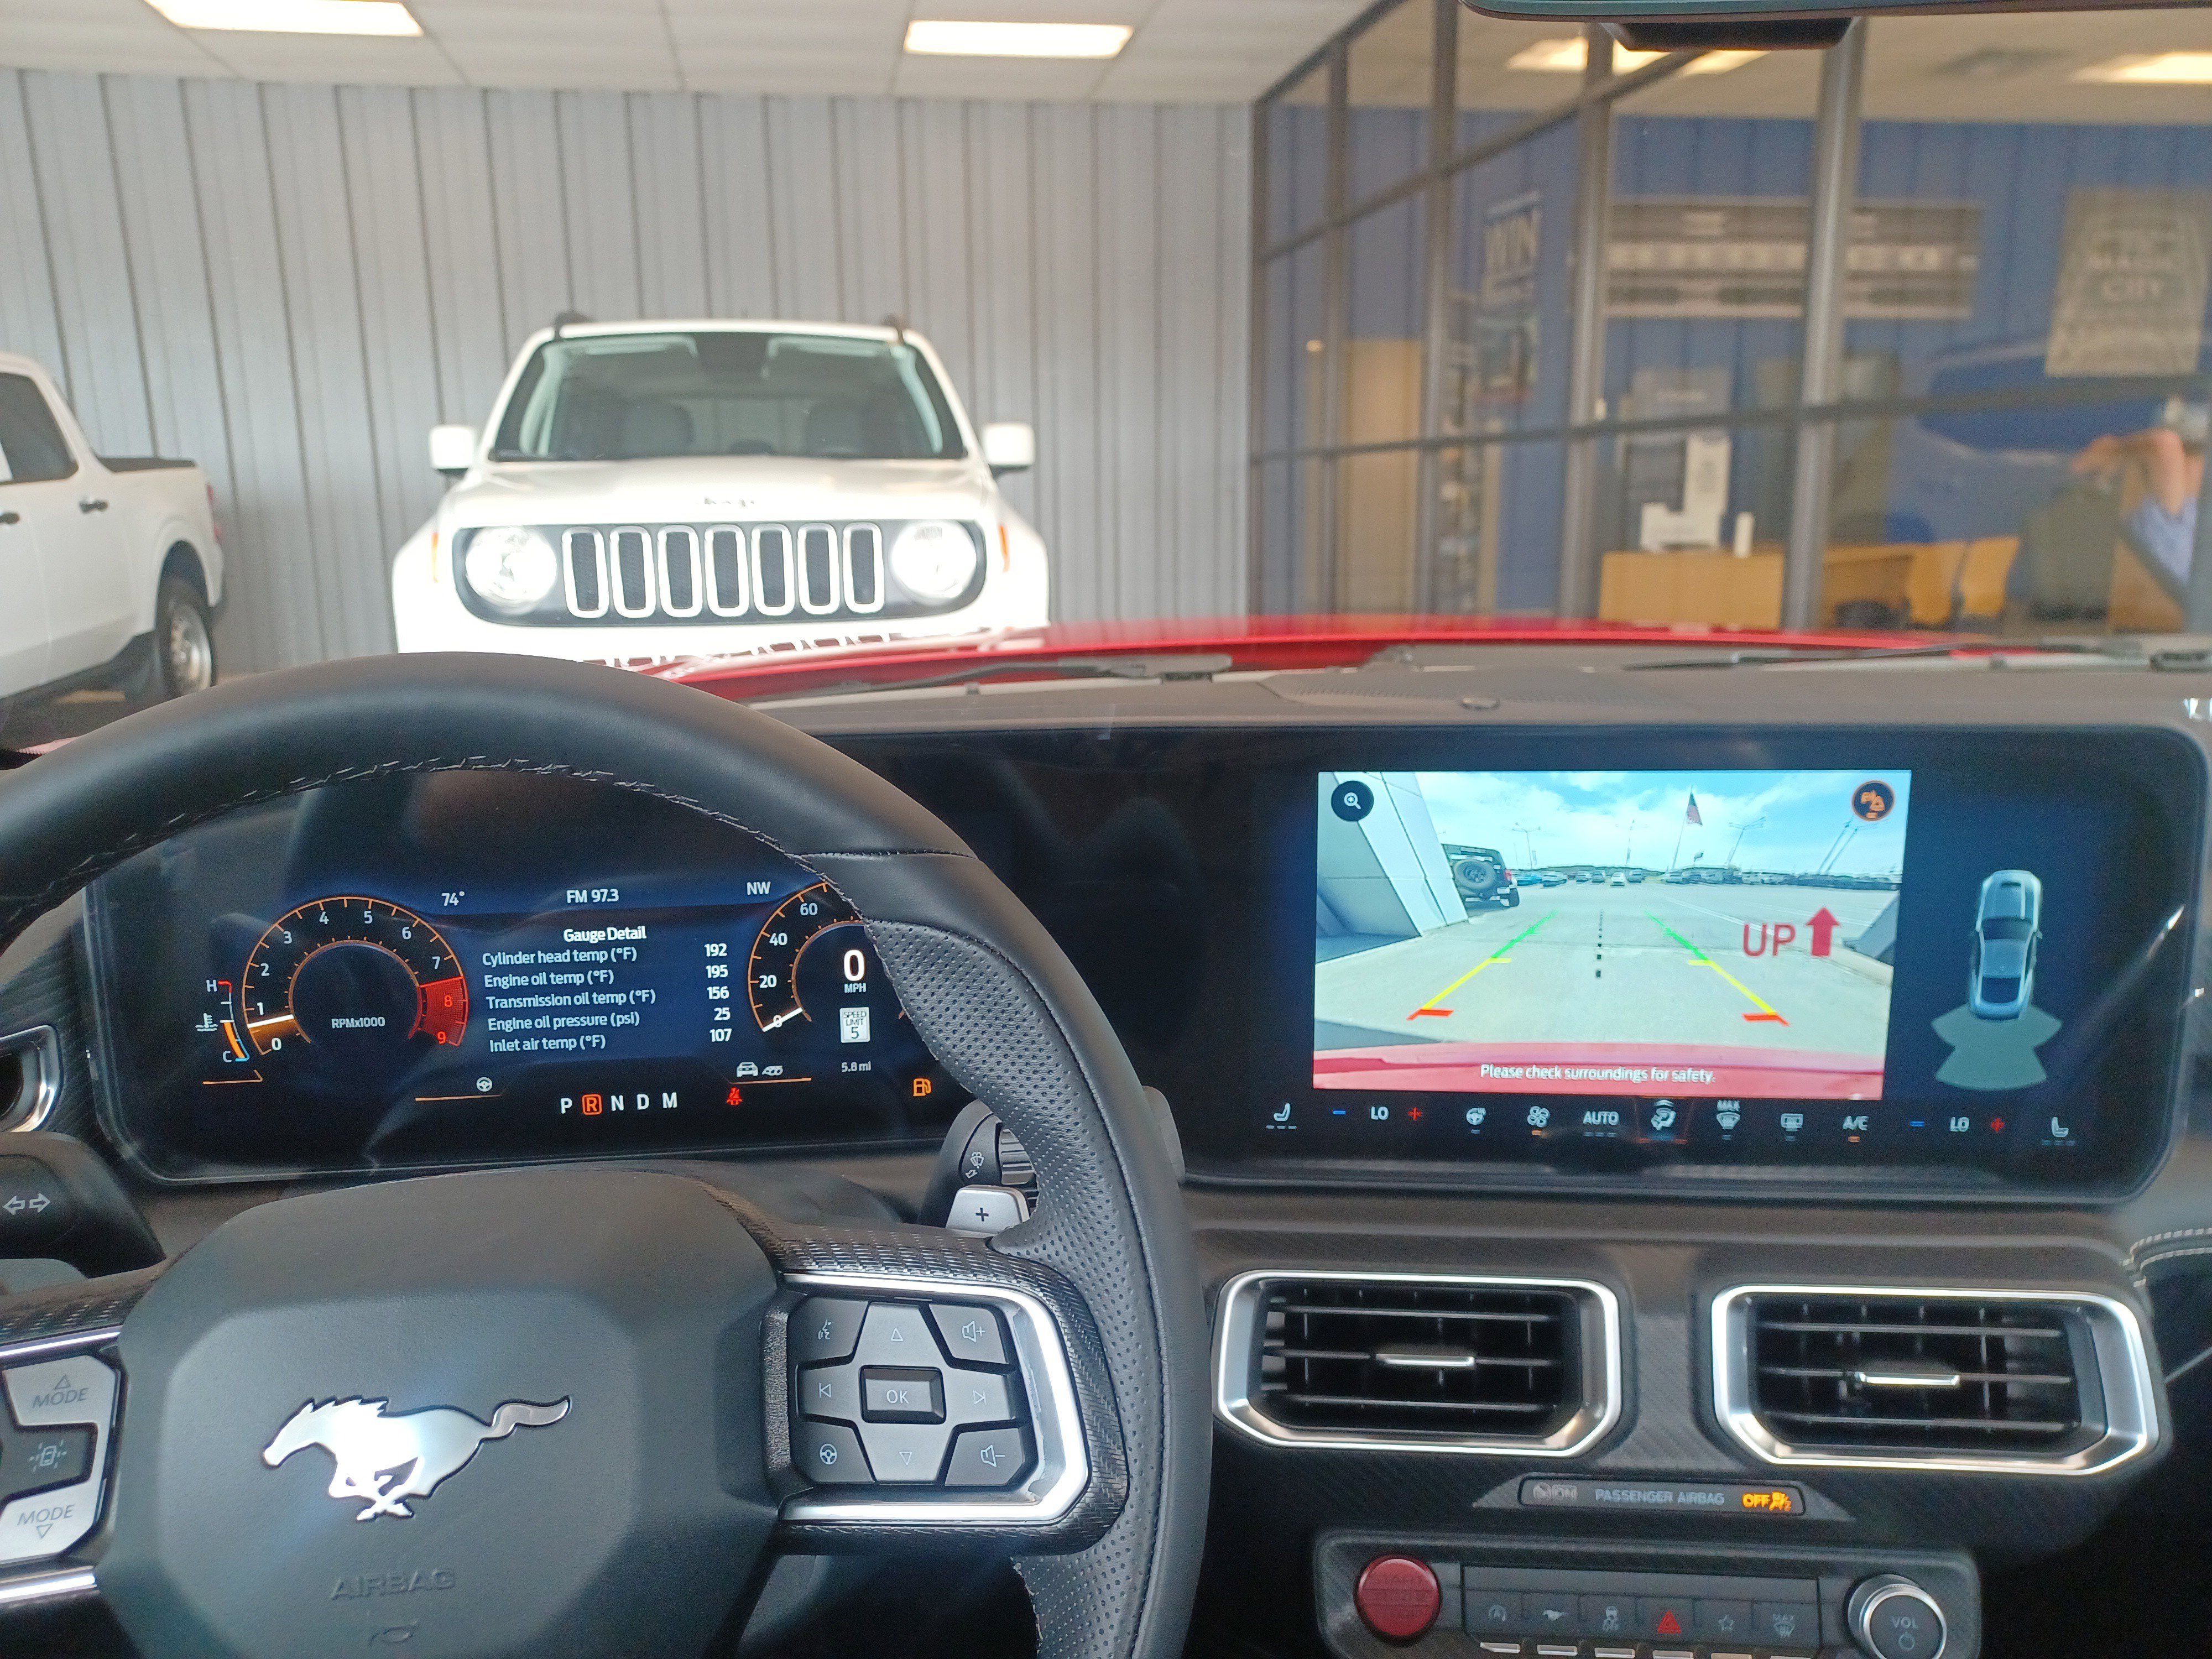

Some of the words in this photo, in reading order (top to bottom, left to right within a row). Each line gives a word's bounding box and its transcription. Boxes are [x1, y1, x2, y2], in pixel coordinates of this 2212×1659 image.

[747, 881, 771, 895] NW
[566, 889, 588, 904] FM
[591, 888, 619, 902] 97.3
[800, 902, 818, 916] 60
[319, 911, 330, 925] 4
[364, 910, 373, 924] 5
[283, 931, 293, 944] 3
[401, 926, 412, 940] 6
[563, 928, 606, 944] Gauge
[606, 925, 647, 941] Detail
[769, 932, 788, 946] 40
[1743, 923, 1796, 957] UP
[432, 956, 441, 969] 7
[482, 951, 536, 968] Cylinder
[537, 949, 571, 963] head
[572, 949, 608, 963] temp
[704, 943, 727, 957] 192
[260, 963, 270, 977] 2
[843, 949, 865, 982] 0
[484, 974, 529, 989] Engine
[530, 972, 548, 985] oil
[549, 972, 585, 986] temp
[705, 964, 728, 978] 195
[759, 974, 777, 988] 20
[206, 979, 217, 992] H
[844, 982, 867, 993] MPH
[444, 994, 453, 1008] 8
[485, 993, 572, 1009] Transmission
[573, 992, 590, 1005] oil
[591, 992, 627, 1006] temp
[706, 985, 729, 1000] 156
[257, 1001, 264, 1015] 1
[843, 1010, 867, 1019] SPEED
[331, 1016, 385, 1029] RPMx1000
[488, 1017, 533, 1032] Engine
[534, 1015, 551, 1029] oil
[552, 1015, 608, 1030] pressure
[610, 1011, 640, 1027] (psi)
[713, 1007, 731, 1021] 25
[436, 1030, 447, 1045] 9
[851, 1026, 859, 1039] 5
[271, 1037, 282, 1051] 0
[489, 1039, 521, 1052] Inlet
[522, 1037, 540, 1051] air
[541, 1037, 577, 1051] temp
[709, 1028, 732, 1042] 107
[222, 1050, 232, 1063] C
[841, 1062, 858, 1072] 5.8
[1480, 1064, 1523, 1079] Please
[1525, 1065, 1562, 1080] check
[1564, 1066, 1647, 1083] surroundings
[1651, 1067, 1669, 1081] for
[1672, 1067, 1716, 1084] safety.
[560, 1098, 572, 1114] P
[585, 1097, 599, 1113] R
[611, 1095, 624, 1112] N
[637, 1094, 650, 1110] D
[662, 1092, 677, 1109] M
[1371, 1106, 1389, 1120] LO
[1583, 1111, 1620, 1126] AUTO
[1950, 1117, 1969, 1132] LO
[32, 1387, 90, 1408] MODE
[886, 1389, 910, 1405] OK
[1595, 1488, 1674, 1503] PASSENGER
[1677, 1491, 1725, 1505] AIRBAG
[1742, 1493, 1770, 1509] OFF
[17, 1504, 75, 1526] MODE
[330, 1568, 456, 1600] AIRBAG
[1891, 1616, 1919, 1629] VOL
